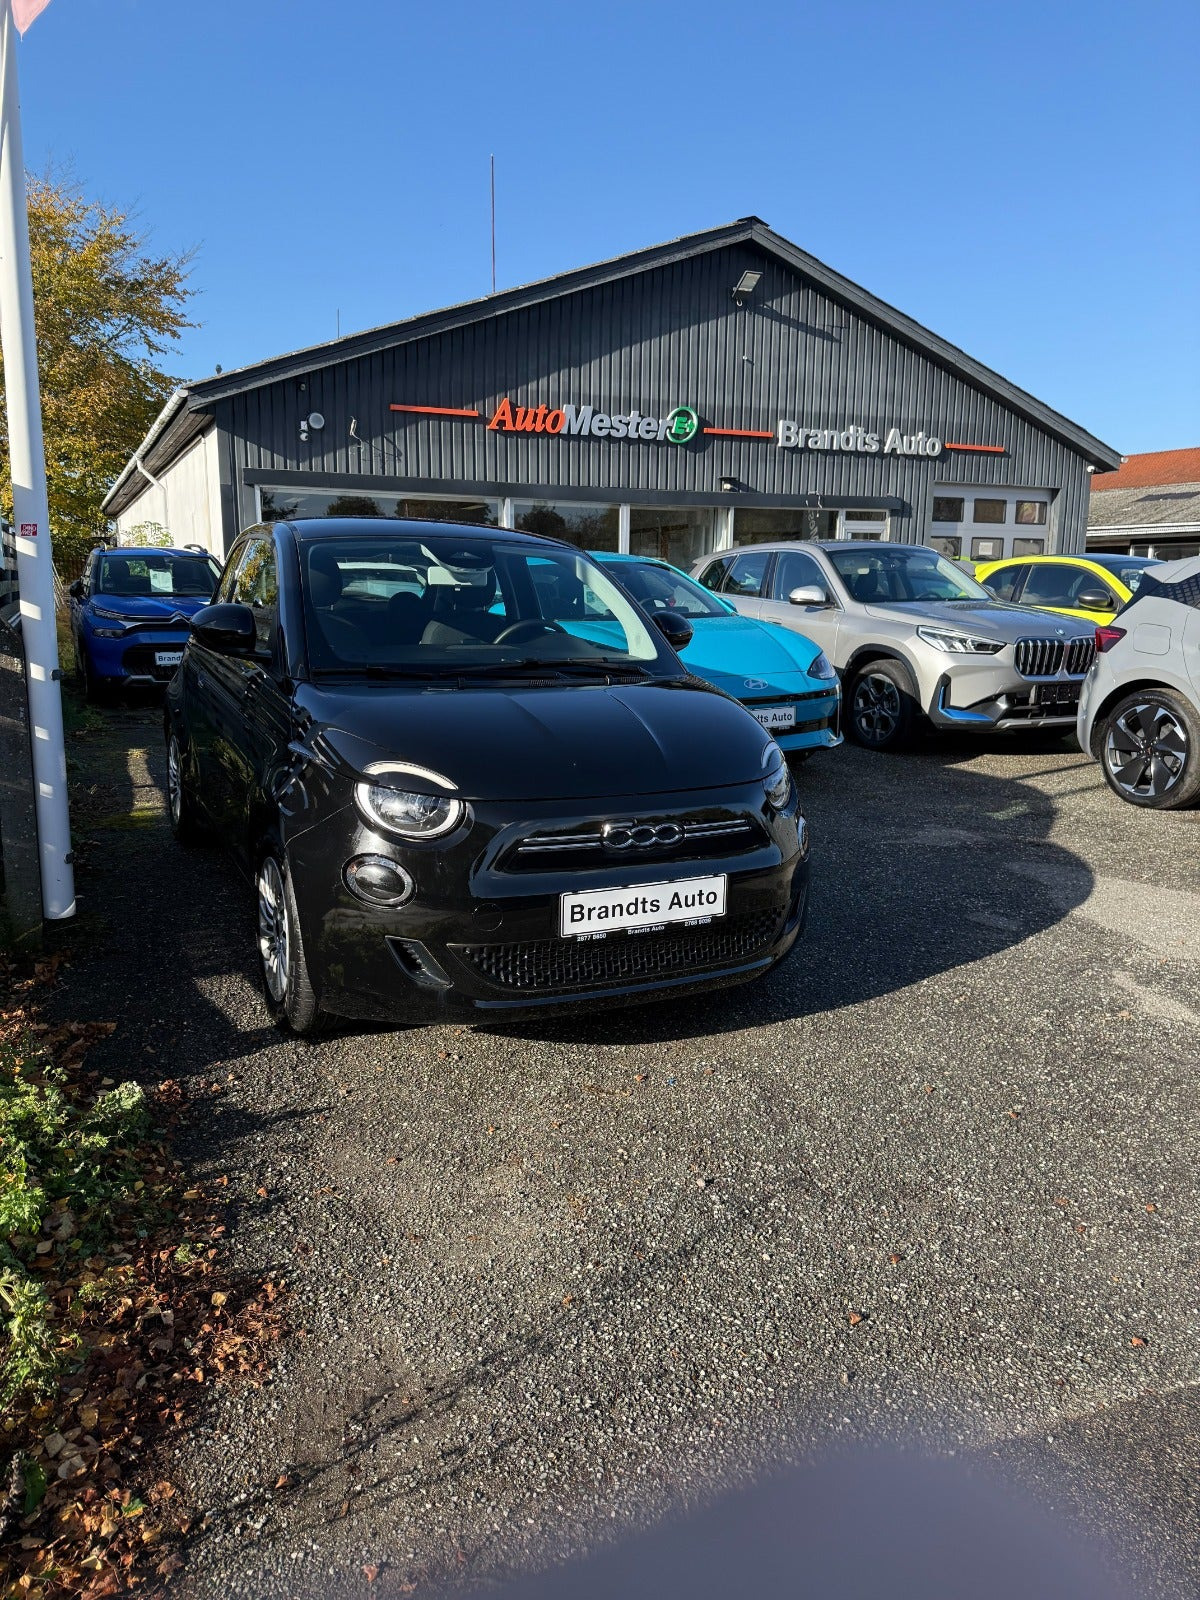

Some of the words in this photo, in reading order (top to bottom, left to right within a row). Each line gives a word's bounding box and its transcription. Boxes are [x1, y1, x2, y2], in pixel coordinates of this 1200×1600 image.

[487, 397, 672, 440] AutoMester
[777, 419, 880, 453] Brandts
[883, 428, 942, 457] Auto
[772, 712, 793, 722] Auto
[570, 897, 660, 923] Brandts
[668, 889, 718, 911] Auto
[627, 926, 651, 935] Brandts
